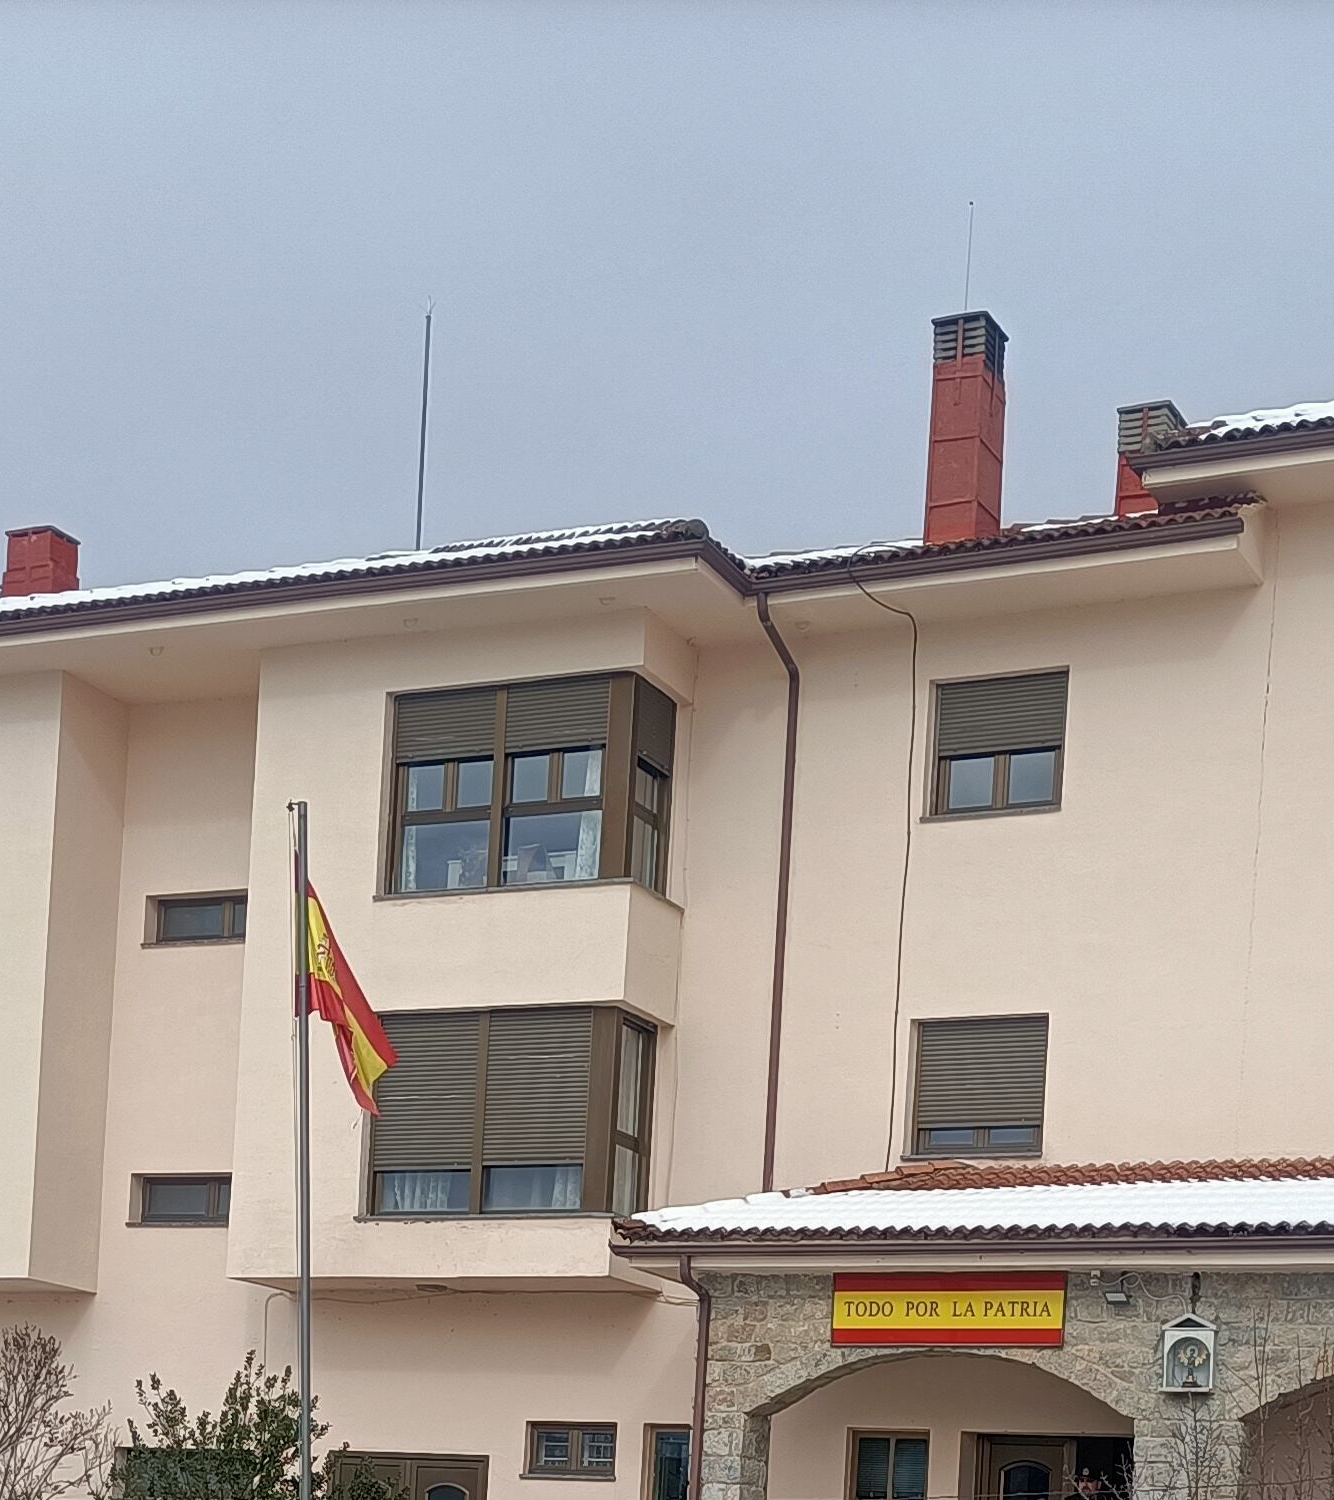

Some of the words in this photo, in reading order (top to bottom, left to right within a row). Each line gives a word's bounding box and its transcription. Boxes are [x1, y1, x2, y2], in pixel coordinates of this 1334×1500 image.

[844, 1300, 894, 1318] TODO
[905, 1300, 941, 1318] POR
[951, 1301, 976, 1318] LA
[983, 1300, 1052, 1318] PATRIA
